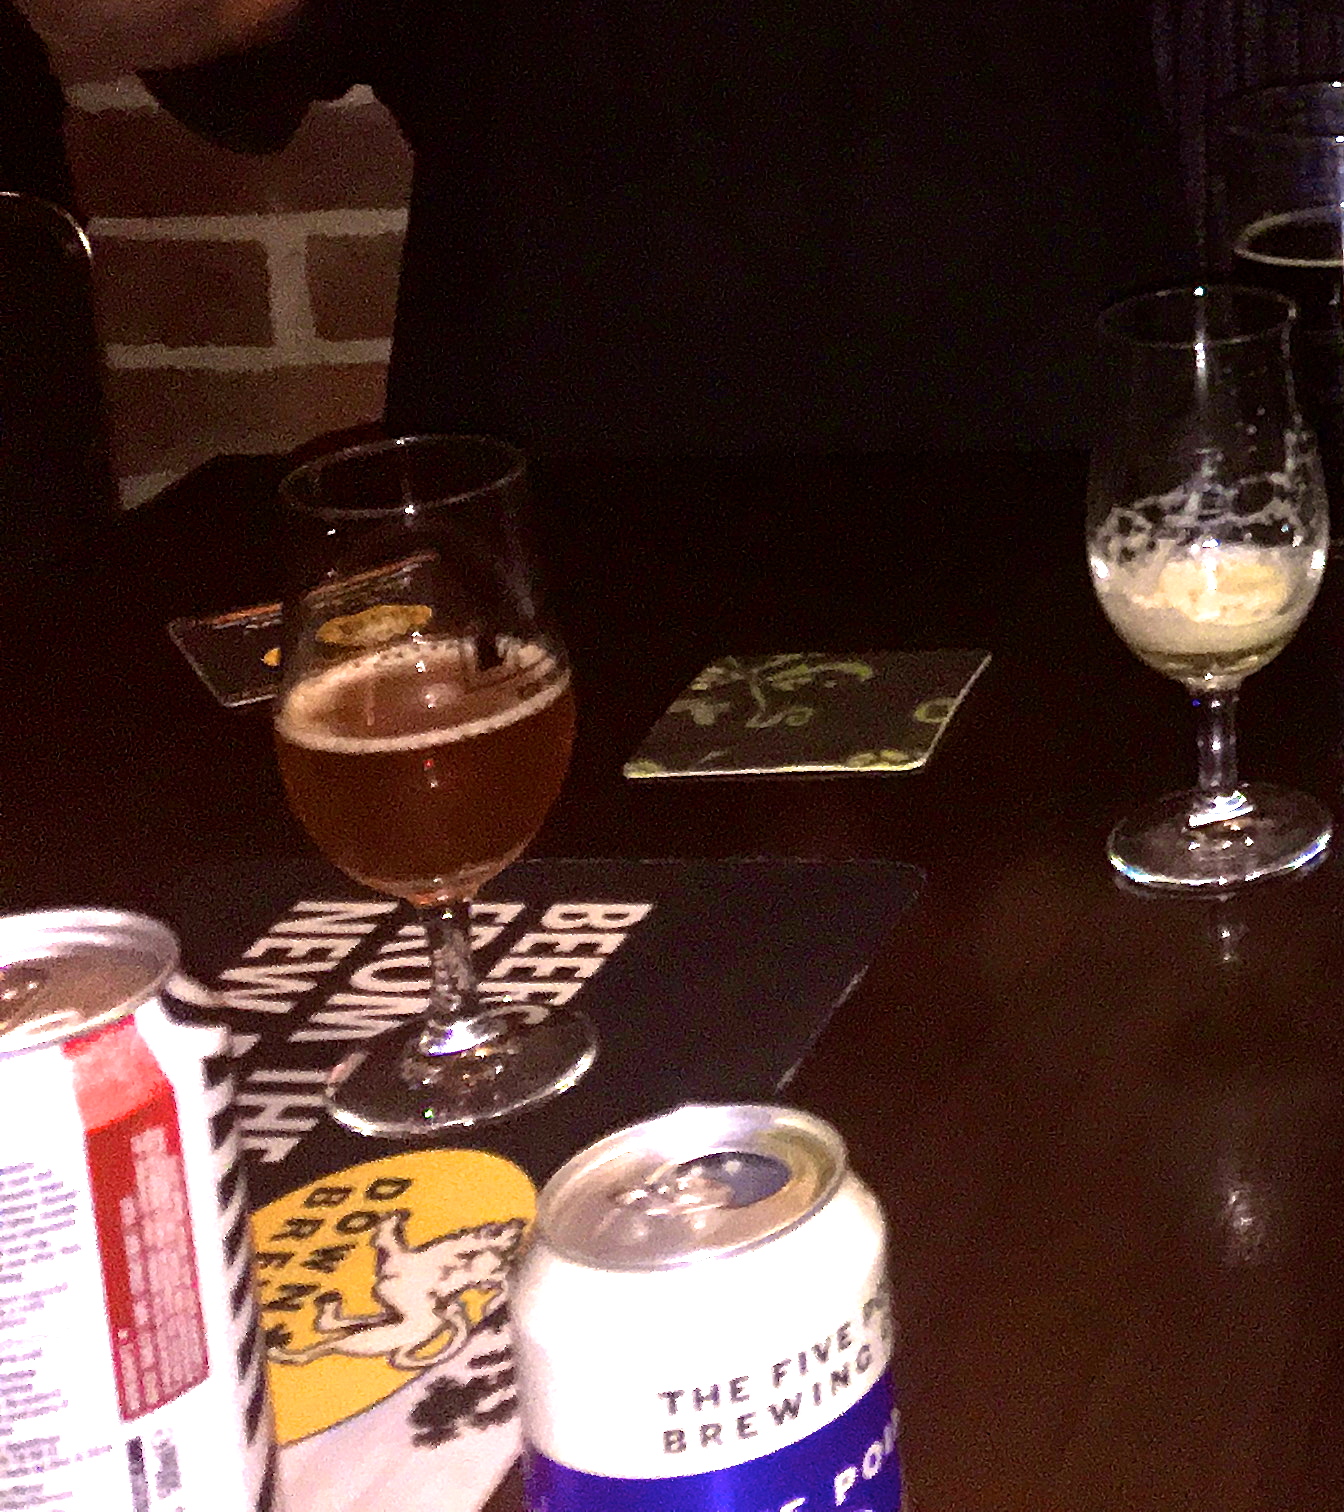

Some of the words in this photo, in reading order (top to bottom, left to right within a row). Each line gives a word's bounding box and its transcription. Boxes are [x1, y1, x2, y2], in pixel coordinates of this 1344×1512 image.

[196, 900, 398, 1014] NEW
[477, 902, 654, 1008] BEER
[657, 1375, 750, 1416] THE
[771, 1320, 852, 1389] FIVE
[663, 1343, 872, 1455] BREWING
